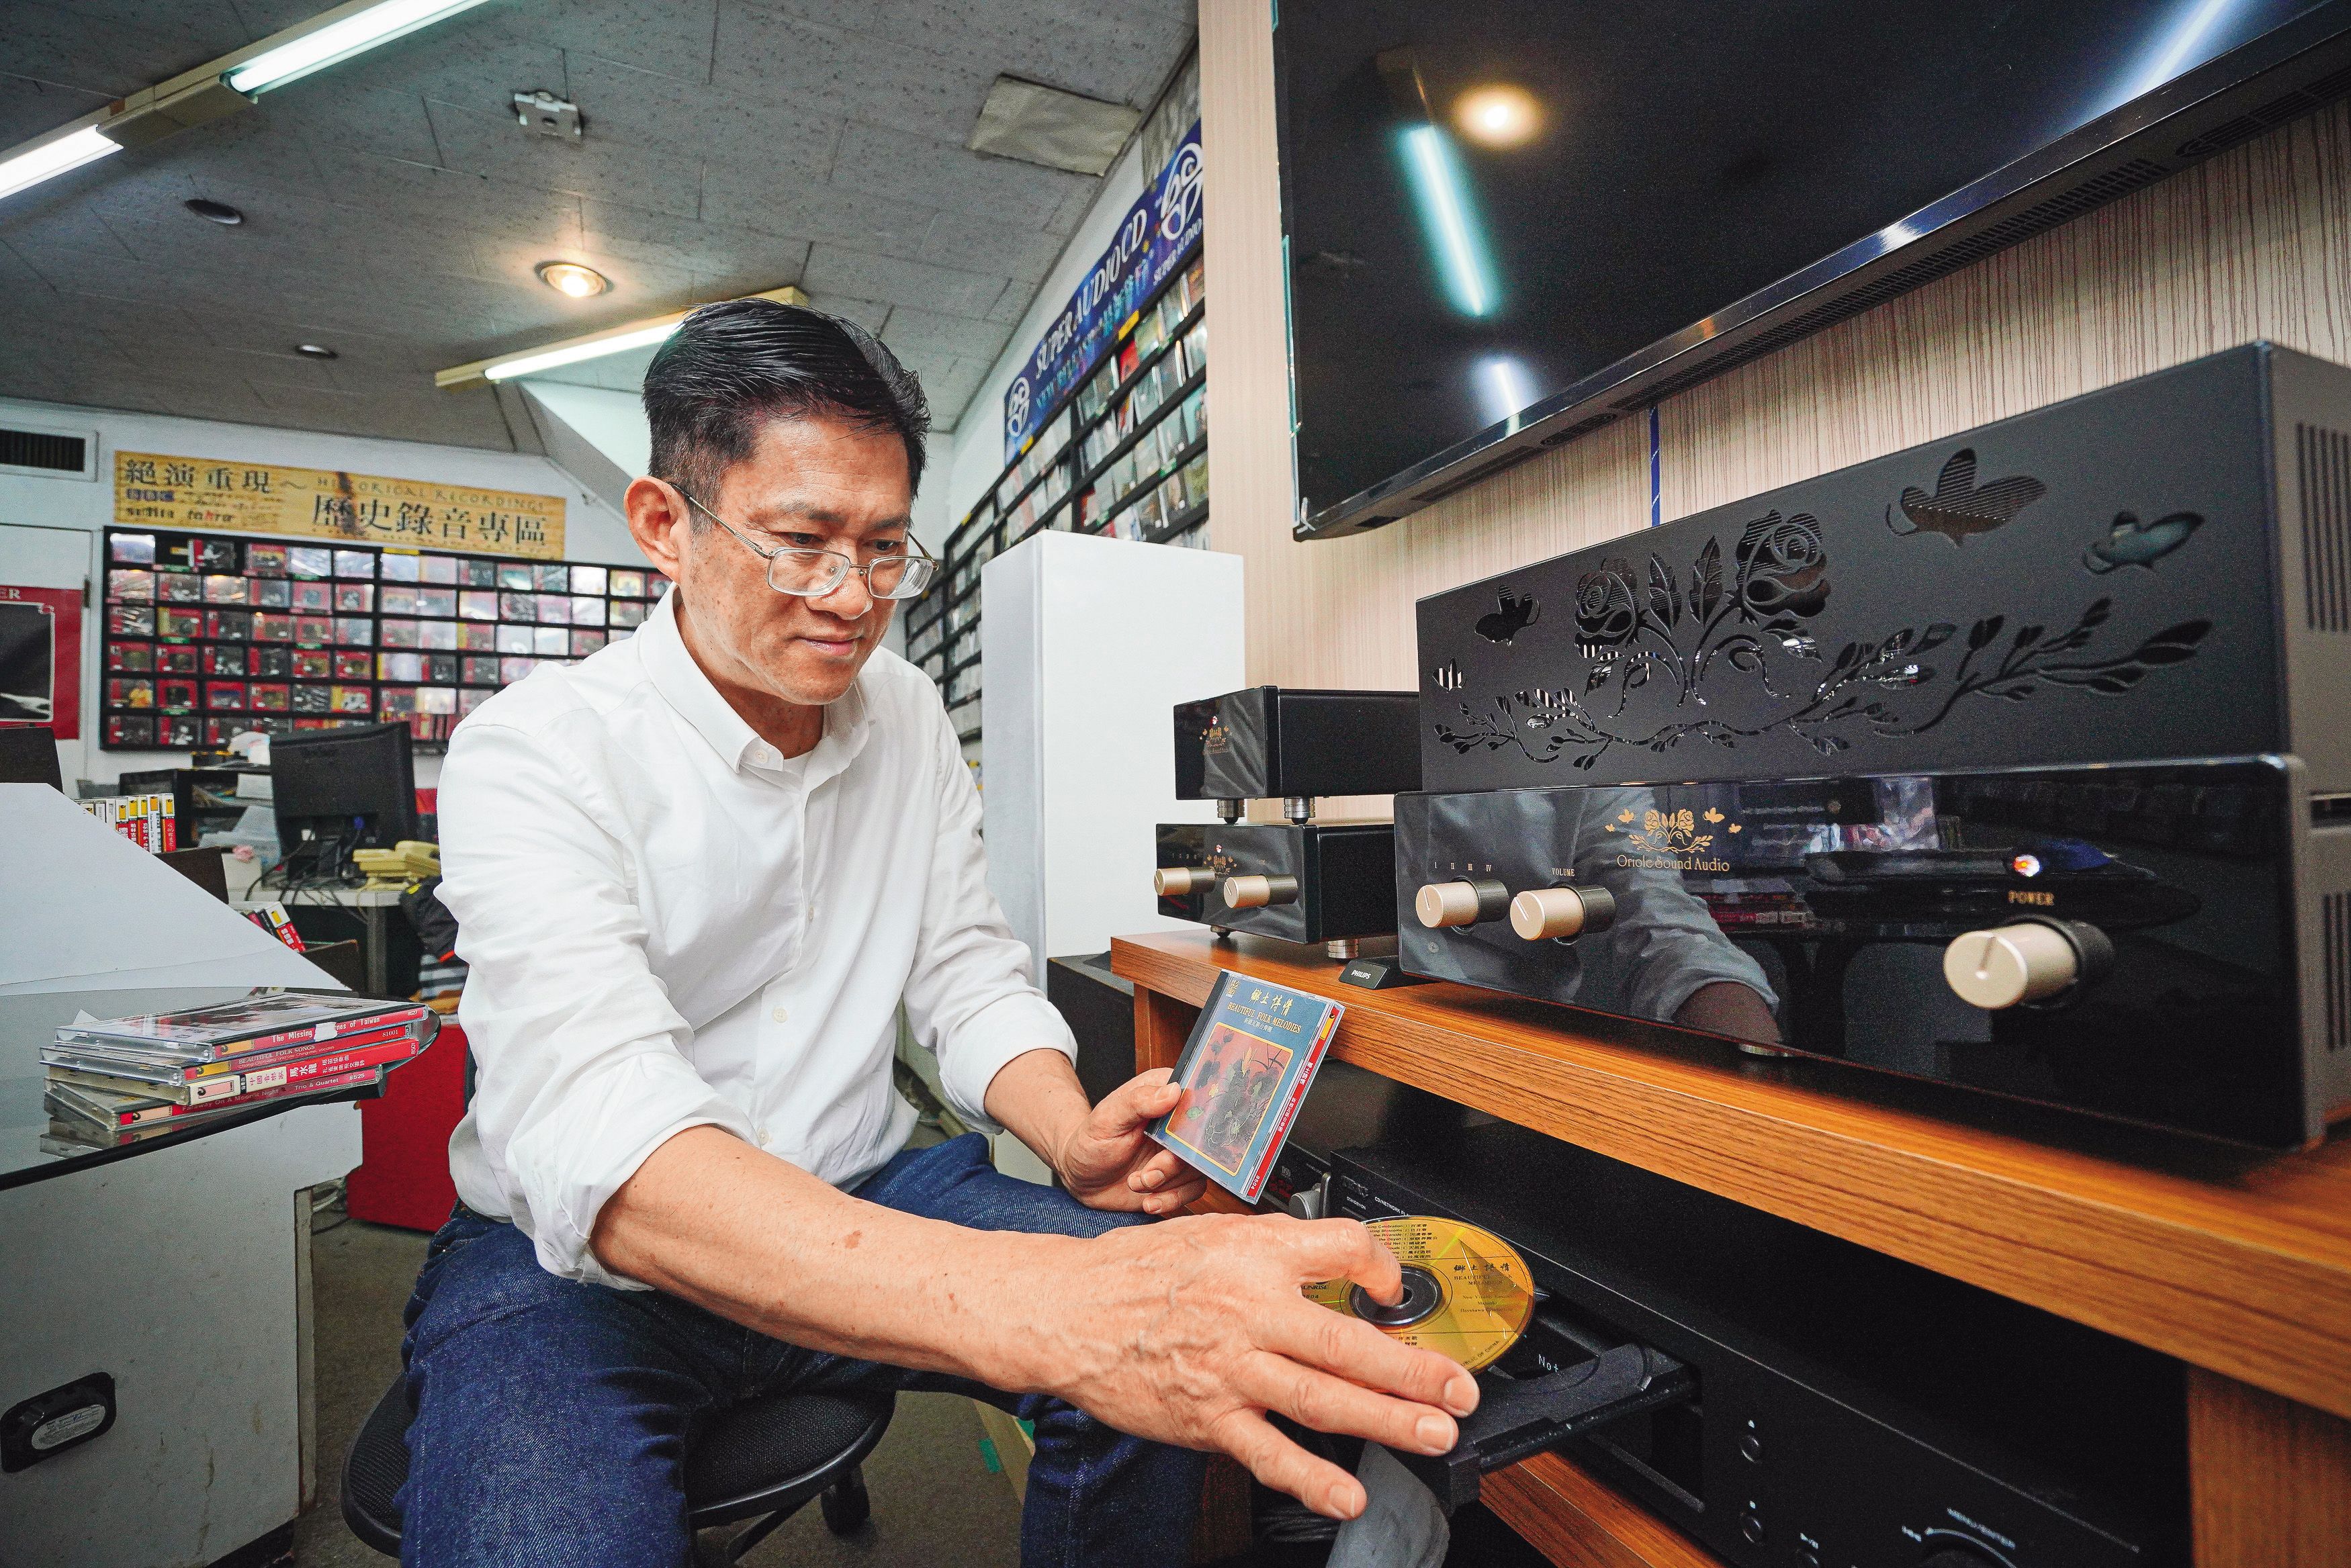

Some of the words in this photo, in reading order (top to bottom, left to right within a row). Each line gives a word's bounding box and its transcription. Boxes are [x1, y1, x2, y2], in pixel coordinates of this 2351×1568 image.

[1036, 312, 1073, 379] SUPER
[1076, 245, 1121, 324] AUDIO
[1122, 209, 1147, 263] CD
[317, 476, 425, 498] HIORICAL
[1617, 854, 1653, 868] Oriole
[1655, 856, 1692, 870] Sound
[1694, 858, 1730, 872] Audio
[1552, 868, 1575, 877] VOLUME
[2008, 890, 2054, 905] POWER
[1351, 969, 1372, 980] PHILIPS
[1227, 1002, 1255, 1017] BEAUTIFUL
[1256, 1011, 1272, 1025] FOLK
[1272, 1017, 1302, 1033] MELODIES
[272, 1034, 285, 1043] The
[287, 1029, 313, 1040] Missing
[350, 1020, 357, 1028] of
[360, 1017, 380, 1026] Taiwan
[238, 1052, 274, 1064] BEAUTIFUL
[275, 1049, 292, 1057] FOLK
[294, 1045, 315, 1054] SONGS
[289, 1062, 318, 1078] 馬水龍
[349, 1072, 365, 1080] 8525
[315, 1078, 339, 1087] Quartet
[1250, 1174, 1260, 1190] 8504
[1374, 1196, 1401, 1213] CD/NETWORK
[1538, 1354, 1558, 1372] Not
